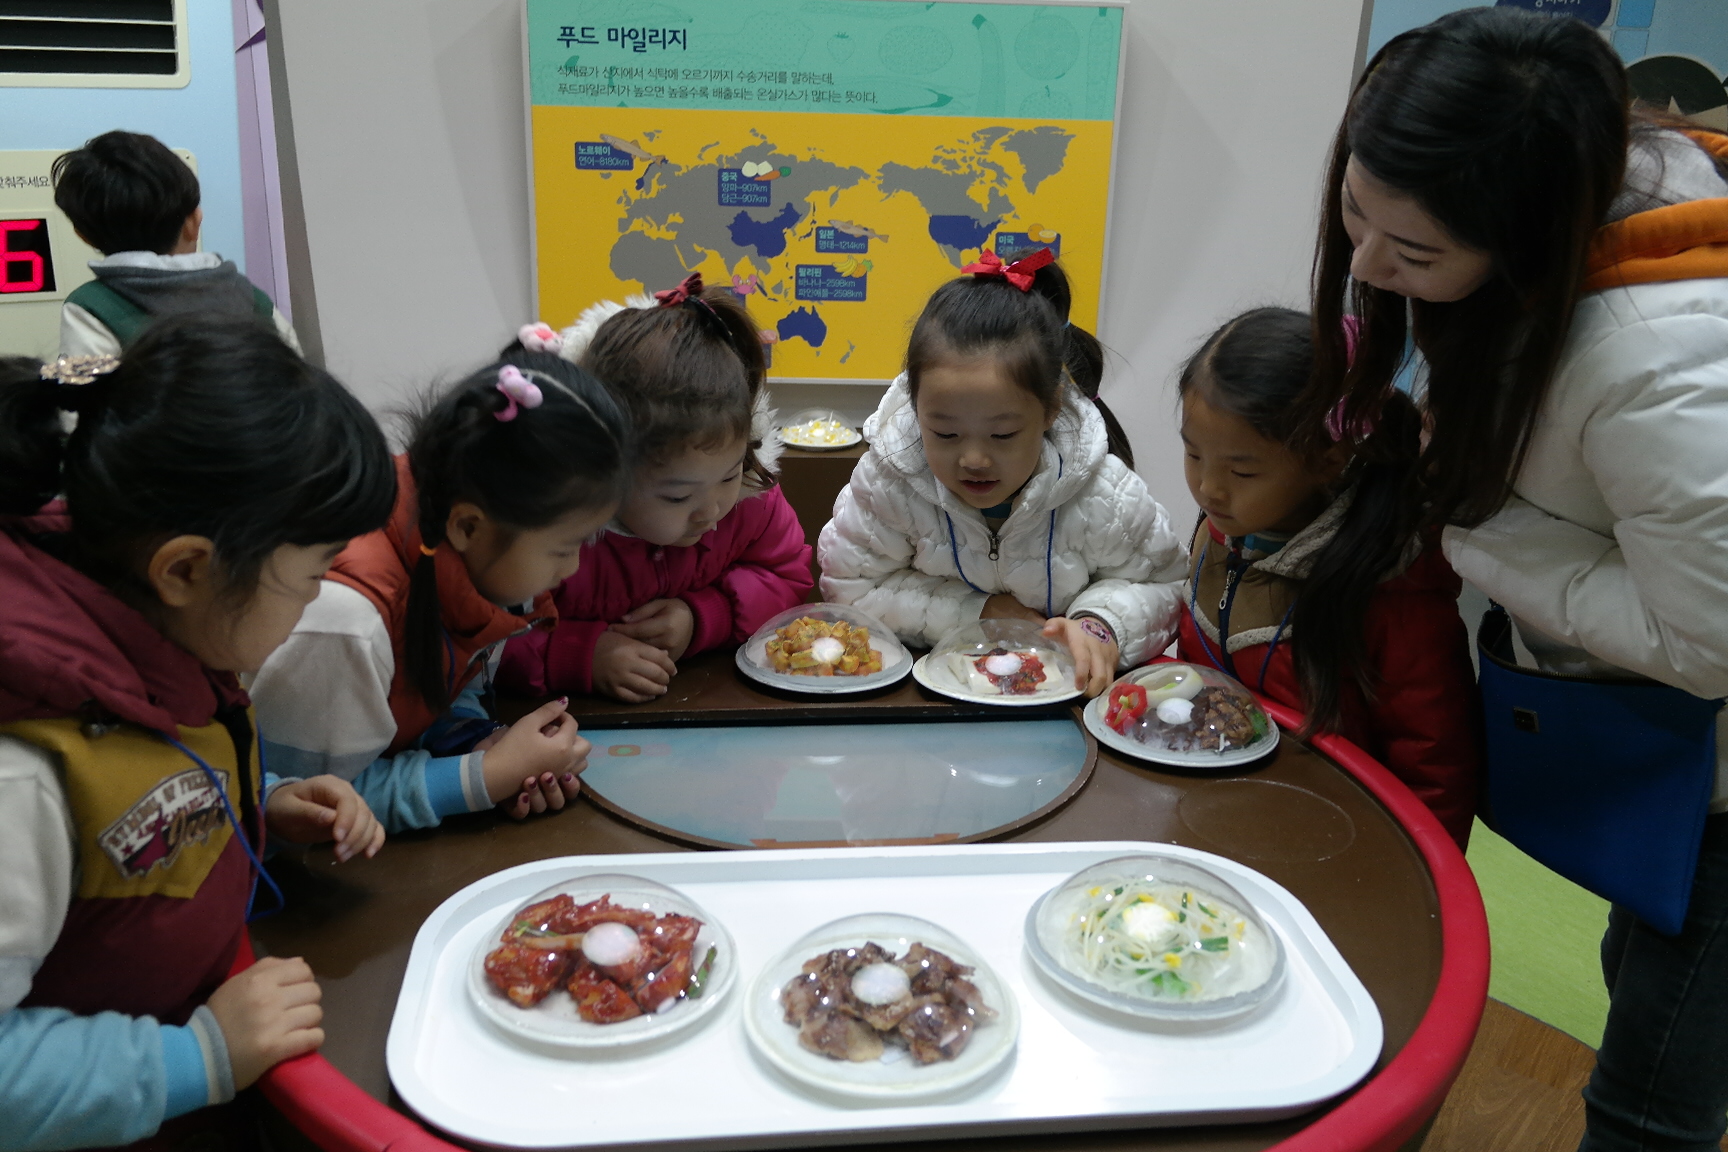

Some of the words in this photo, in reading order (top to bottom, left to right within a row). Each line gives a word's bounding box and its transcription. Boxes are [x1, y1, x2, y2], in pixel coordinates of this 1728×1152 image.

[557, 26, 600, 48] 푸드
[607, 26, 687, 53] 마일리지
[557, 65, 599, 78] 식재료가
[602, 66, 644, 79] 산지에서
[647, 67, 679, 80] 식탁에
[681, 69, 734, 82] 오르기까지
[736, 71, 788, 84] 수송거리를
[557, 83, 631, 97] 푸드마일리지가
[633, 84, 665, 98] 높으면
[668, 86, 709, 99] 높을수록
[712, 87, 754, 101] 배출되는
[757, 88, 809, 102] 온실가스가
[811, 90, 842, 103] 많다는
[578, 145, 611, 156] 노르웨이
[721, 171, 737, 182] 중국
[818, 229, 835, 240] 일본
[998, 235, 1015, 245] 미국
[0, 220, 44, 293] 6
[798, 267, 822, 278] 필리핀
